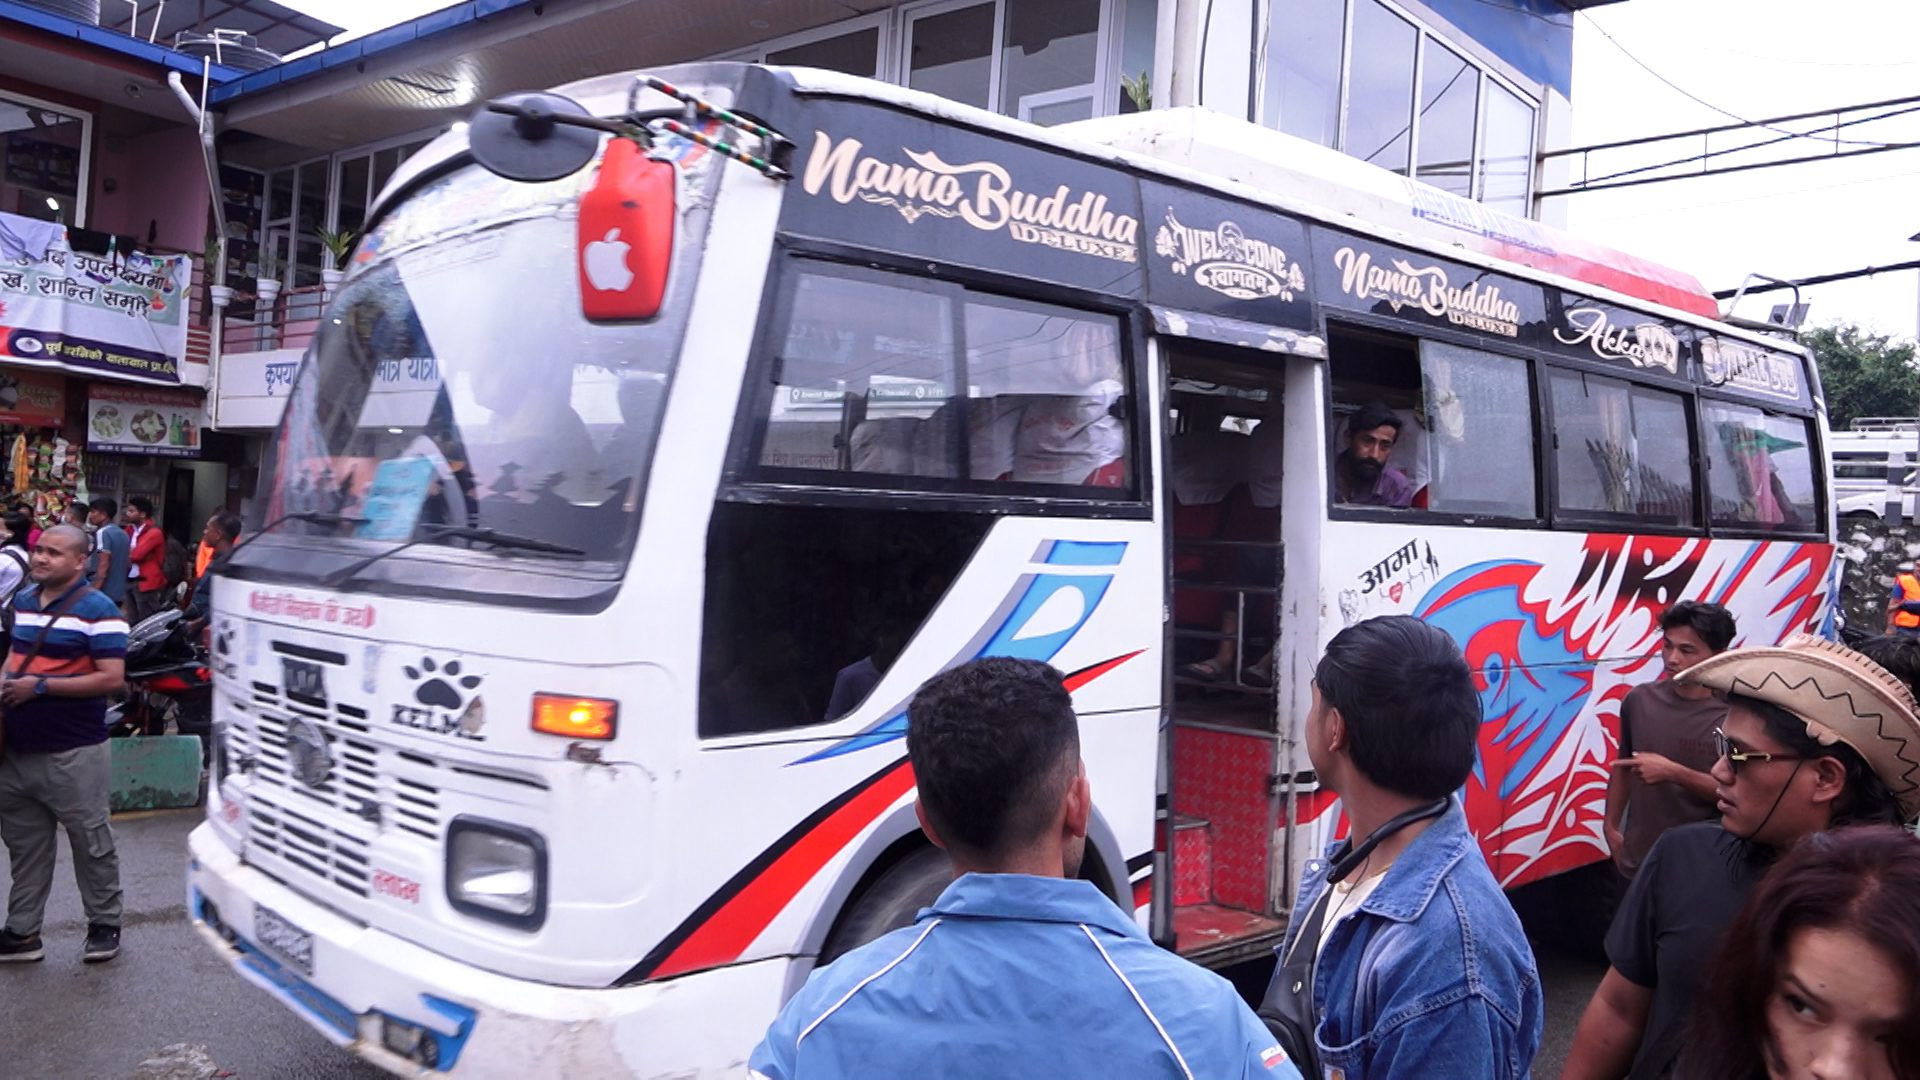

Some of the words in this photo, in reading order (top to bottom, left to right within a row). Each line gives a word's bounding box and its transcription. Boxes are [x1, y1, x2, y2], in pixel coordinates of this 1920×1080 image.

[803, 129, 963, 206] Namo
[902, 146, 1138, 244] Buddha
[1010, 222, 1137, 263] DELUXE
[1173, 222, 1287, 279] WELCOME
[38, 277, 95, 301] शान्ति
[1334, 247, 1423, 299] Namo
[1391, 257, 1520, 324] Buddha
[1553, 308, 1645, 368] Akka
[265, 362, 298, 396] कृपया
[1357, 538, 1418, 594] आमा
